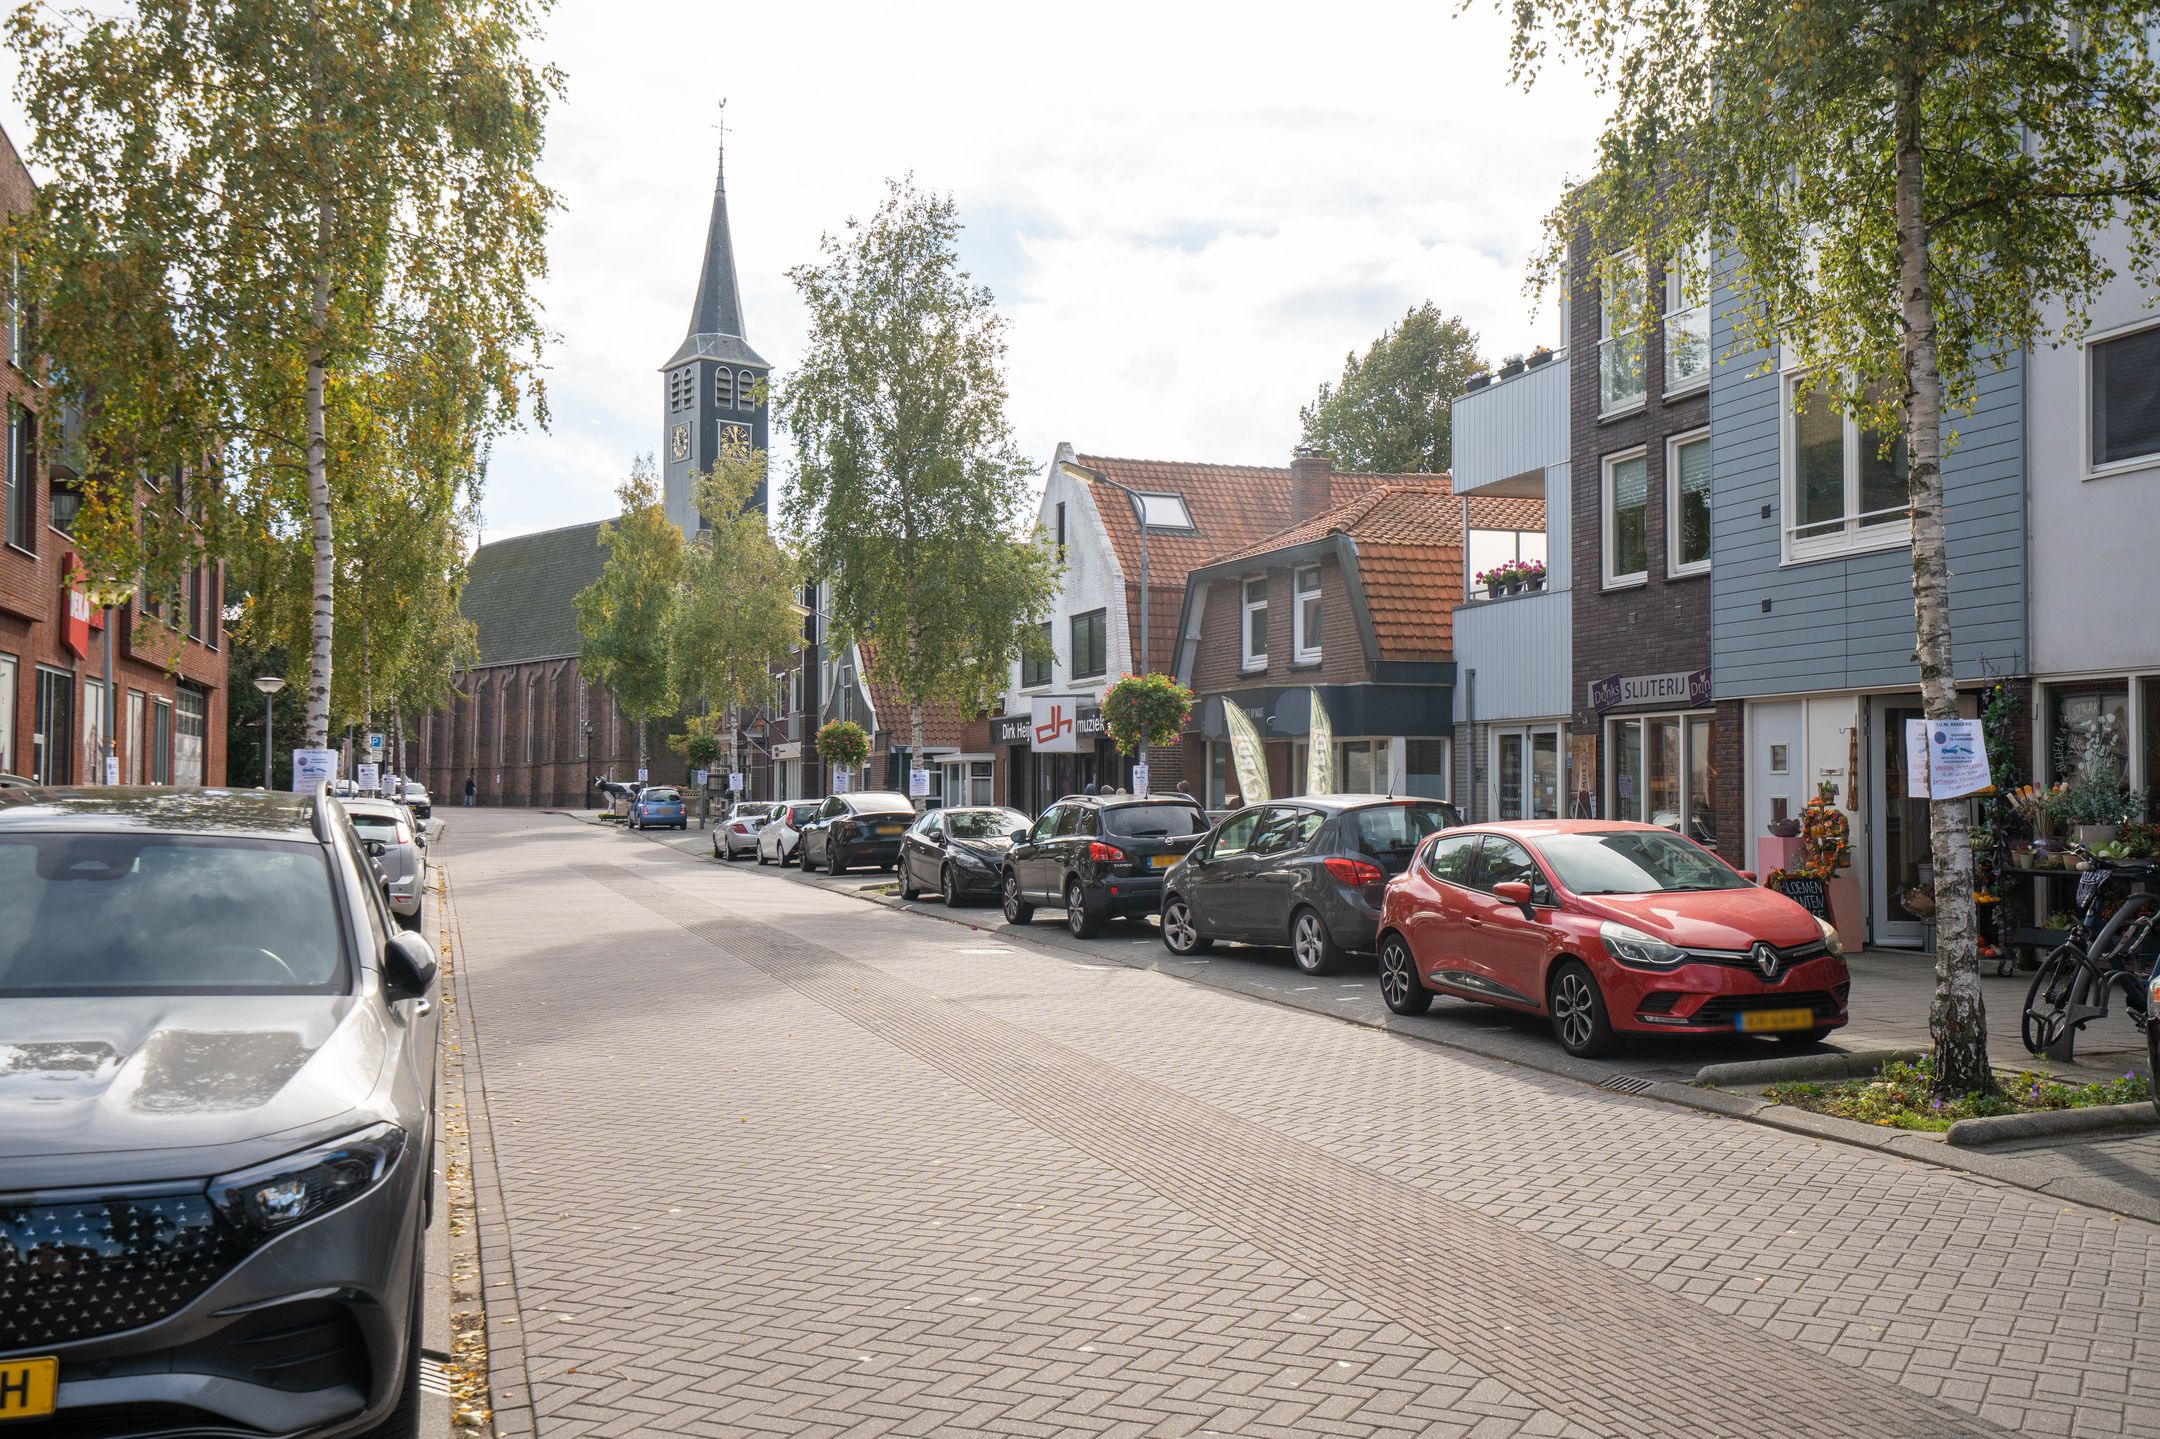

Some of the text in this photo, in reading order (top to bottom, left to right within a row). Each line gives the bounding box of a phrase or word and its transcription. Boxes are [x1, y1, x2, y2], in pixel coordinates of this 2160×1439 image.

[1624, 677, 1685, 699] SLIJTERIJ
[1002, 723, 1016, 740] Dirk
[1076, 714, 1105, 733] muziek
